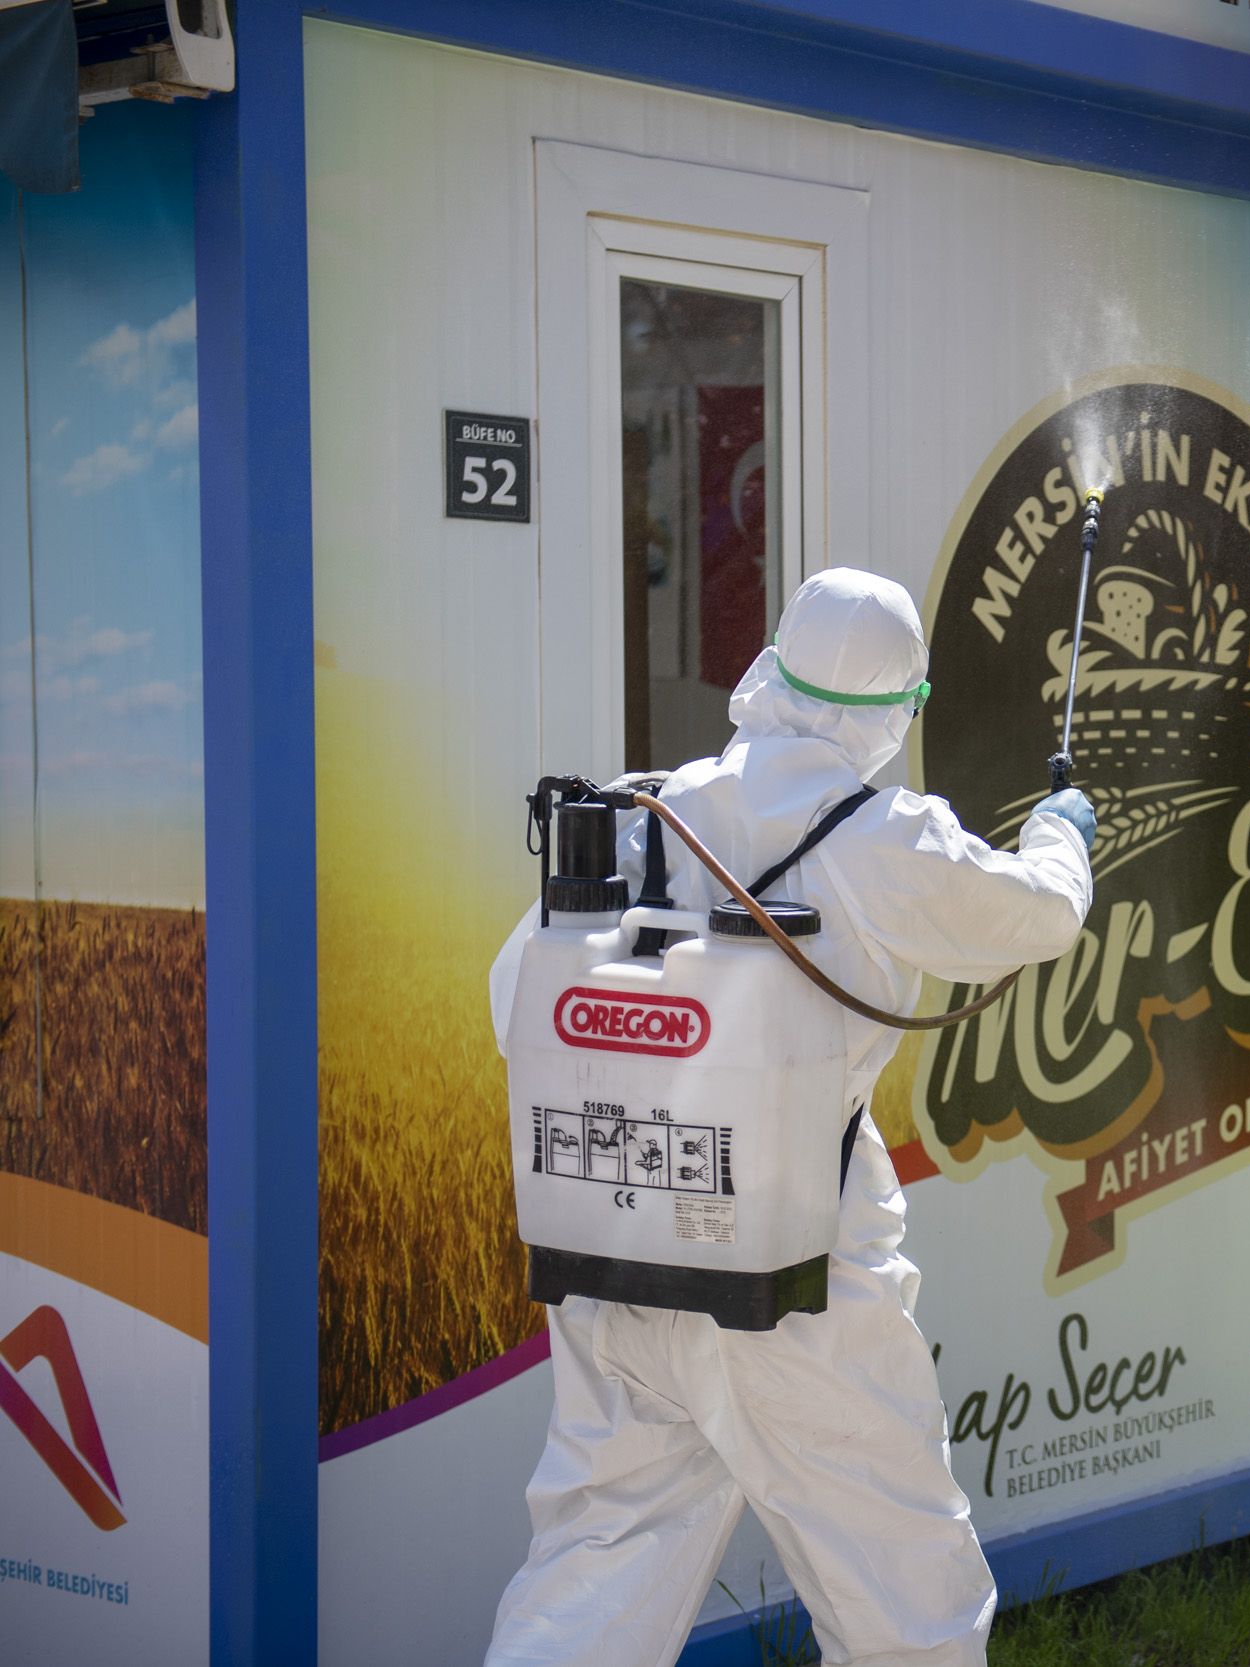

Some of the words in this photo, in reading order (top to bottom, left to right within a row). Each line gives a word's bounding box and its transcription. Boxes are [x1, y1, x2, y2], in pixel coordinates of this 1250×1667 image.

[462, 424, 494, 441] BÜFE
[497, 429, 516, 443] NO
[461, 456, 518, 506] 52
[571, 1003, 690, 1043] OREGON
[583, 1101, 625, 1117] 518769
[651, 1108, 674, 1122] 16L
[1098, 1118, 1207, 1201] AFİYET
[614, 1190, 635, 1209] CE
[931, 1343, 1031, 1497] ap
[1048, 1313, 1186, 1420] Seçer
[1006, 1444, 1038, 1469] T.C.
[1042, 1426, 1108, 1460] MERSİN
[1113, 1398, 1215, 1442] BÜYÜKŞEHİR
[1007, 1459, 1087, 1498] BELEDİYE
[1092, 1440, 1161, 1475] BAŞKANI
[47, 1568, 129, 1605] BELEDİYESİ
